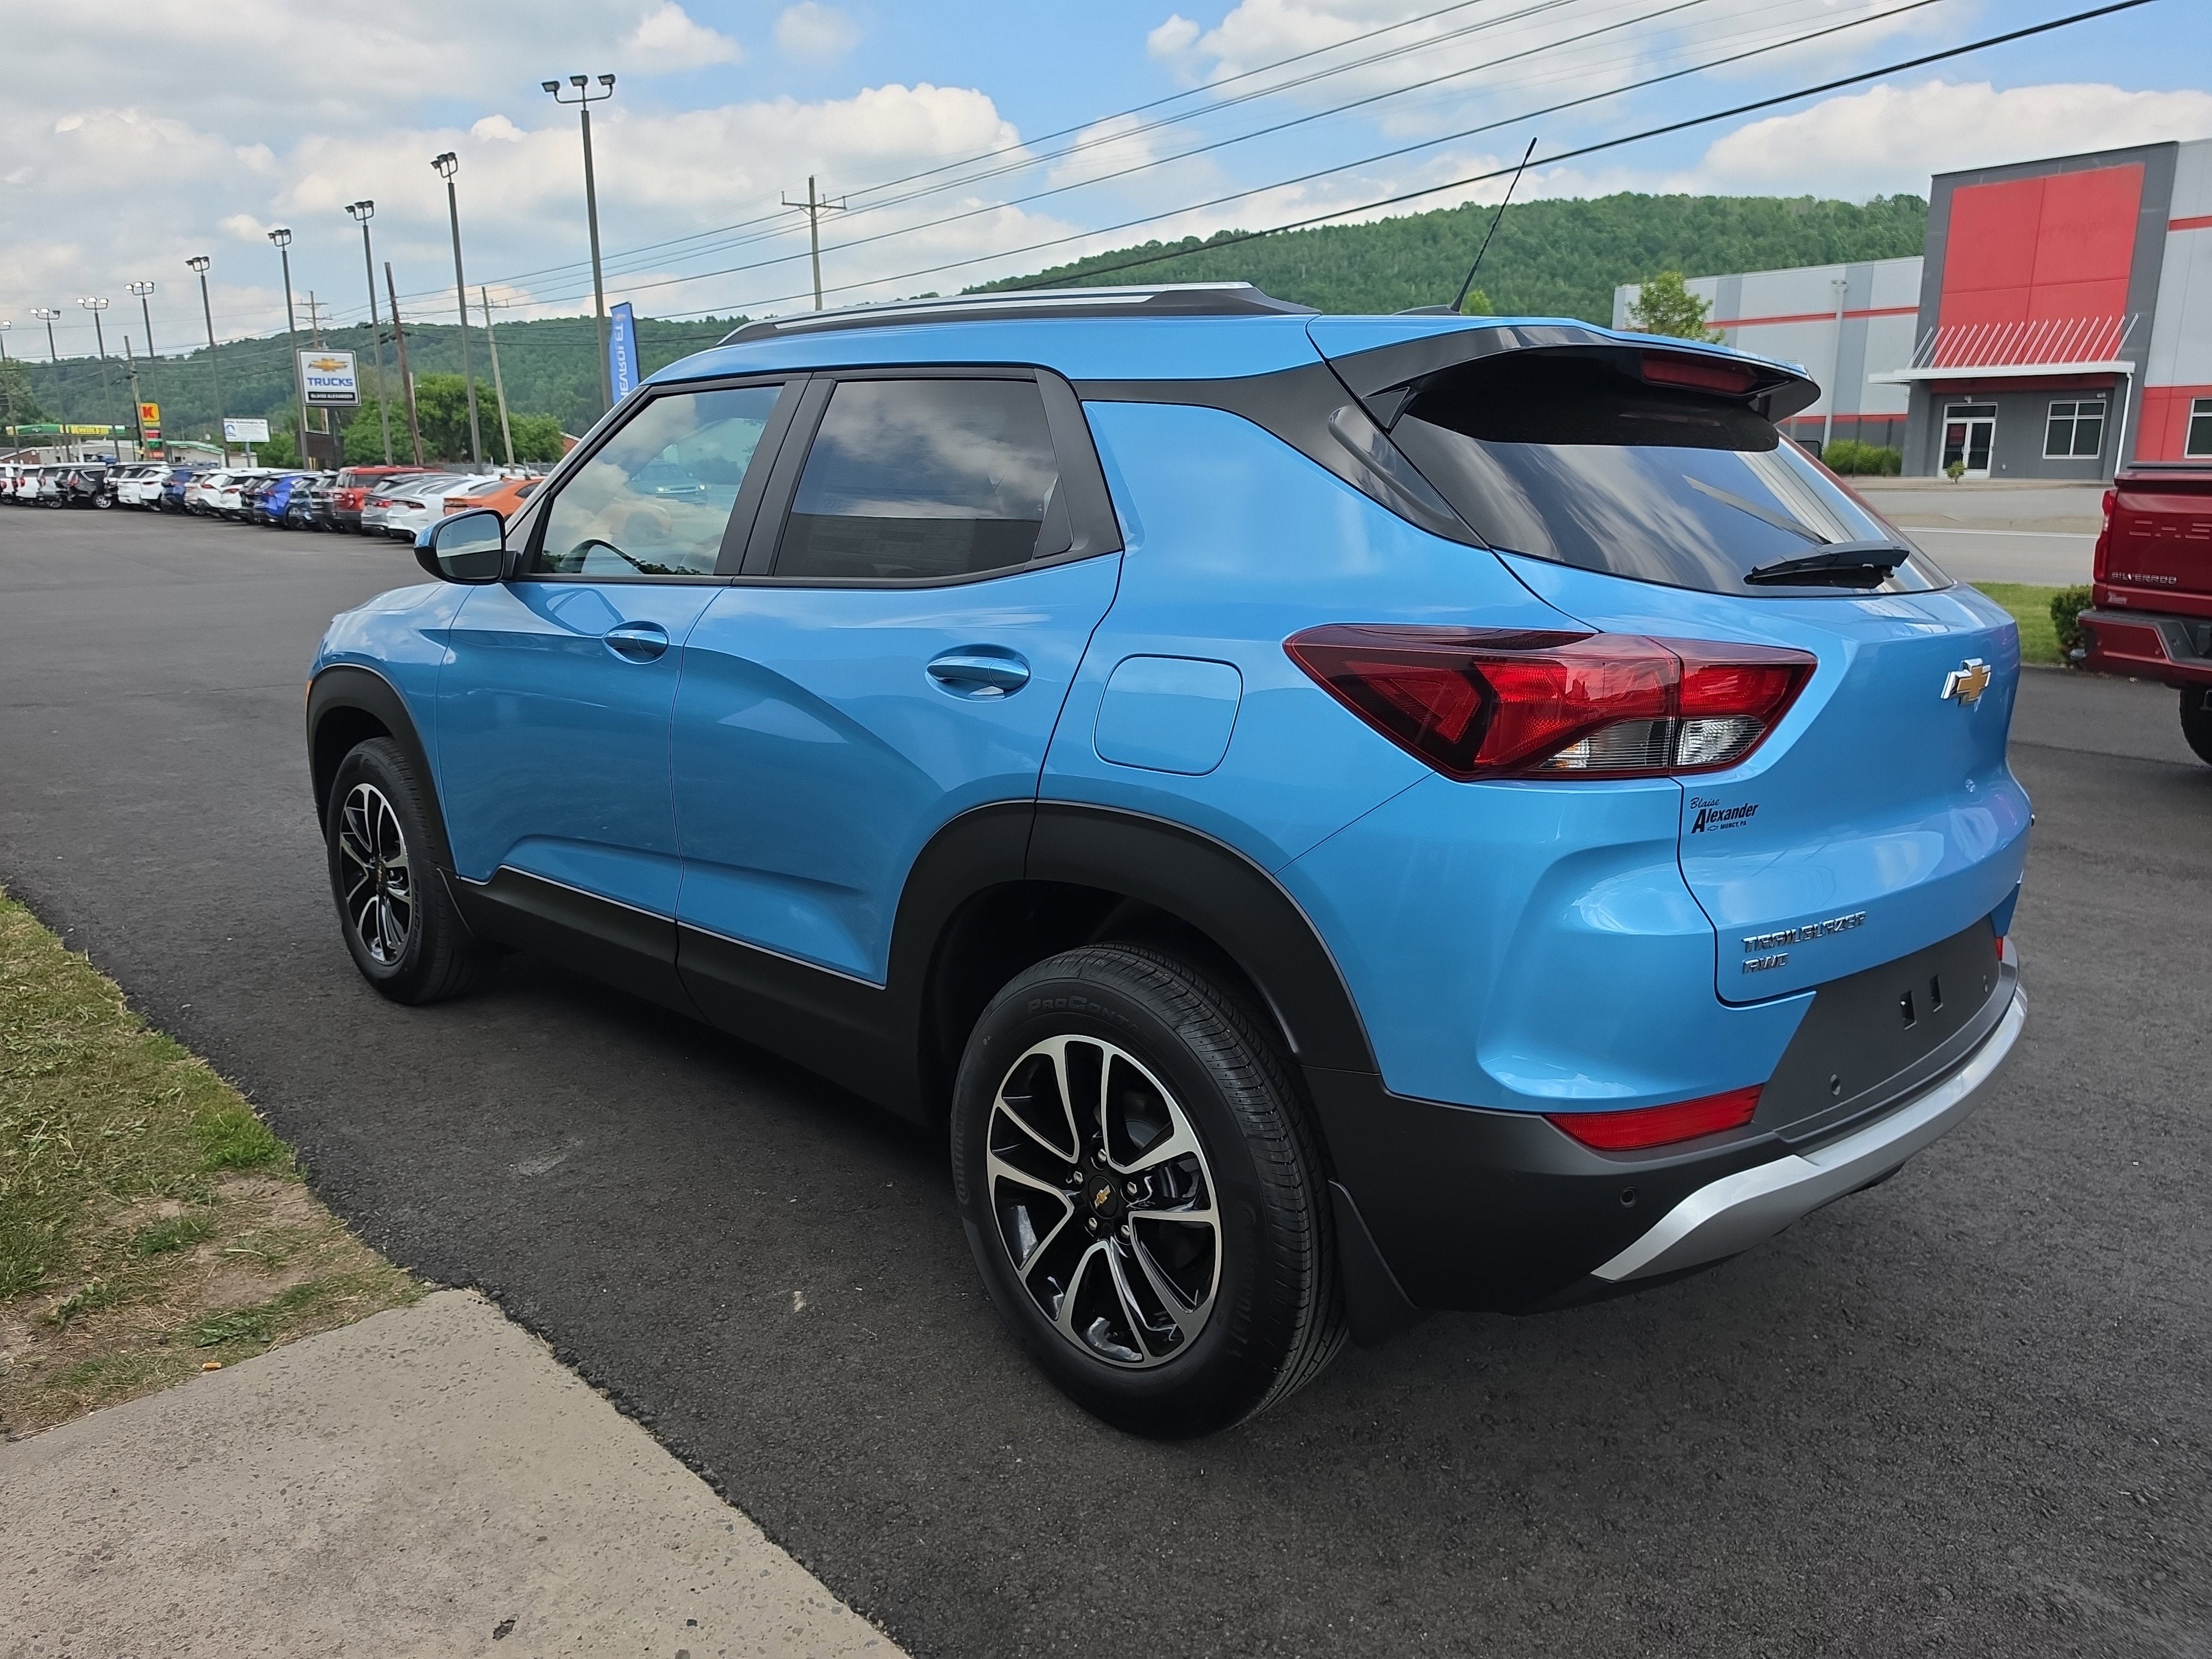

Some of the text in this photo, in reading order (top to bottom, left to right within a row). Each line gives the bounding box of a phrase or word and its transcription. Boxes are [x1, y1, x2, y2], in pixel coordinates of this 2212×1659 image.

[307, 377, 353, 387] TRUCKS
[143, 407, 156, 419] K
[2111, 571, 2177, 584] SILVERADO
[1690, 796, 1720, 809] Blaise
[1690, 802, 1759, 834] Alexander
[1720, 821, 1739, 830] MUNCY,
[1741, 910, 1866, 953] TRAILBLAZER
[1742, 952, 1789, 974] AWD
